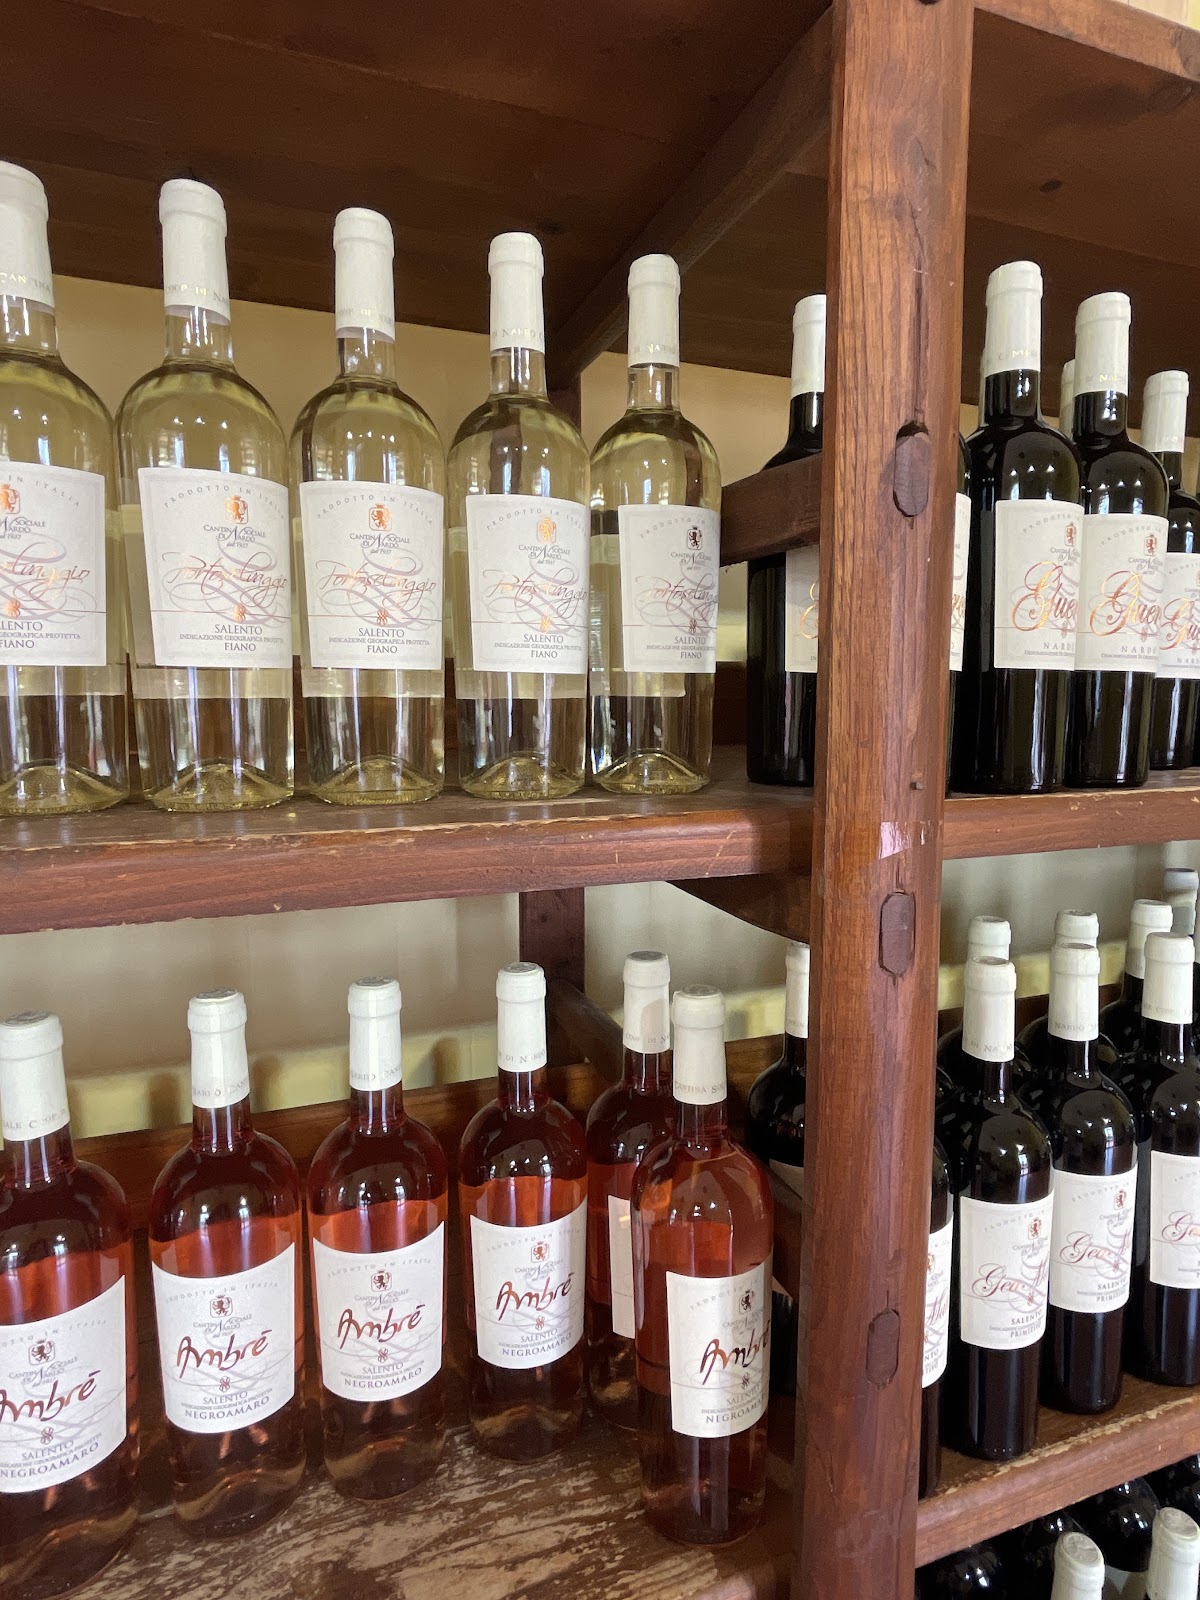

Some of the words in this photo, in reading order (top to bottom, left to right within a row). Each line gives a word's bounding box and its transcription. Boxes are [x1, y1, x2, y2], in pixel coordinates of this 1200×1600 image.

[164, 485, 230, 508] PRODOTTO
[317, 494, 374, 518] PRODOTTO
[15, 519, 46, 528] SOCIALE
[386, 535, 410, 544] SOCIALE
[0, 621, 43, 632] LENTO
[215, 624, 263, 636] SALENTO
[358, 628, 405, 638] SALENTO
[523, 634, 564, 643] SALENTO
[674, 636, 707, 645] SALENTO
[224, 643, 257, 652] FIANO
[367, 645, 398, 654] FIANO
[531, 650, 558, 659] FIANO
[520, 1328, 558, 1343] SALENTO
[503, 1332, 572, 1357] NEGROAMARO
[362, 1361, 404, 1374] SALENTO
[344, 1367, 422, 1389] NEGROAMARO
[203, 1390, 248, 1405] SALENTO
[185, 1396, 270, 1420] NEGROAMARO
[22, 1440, 74, 1461] SALENTO
[0, 1442, 99, 1478] NEGROAMARO
